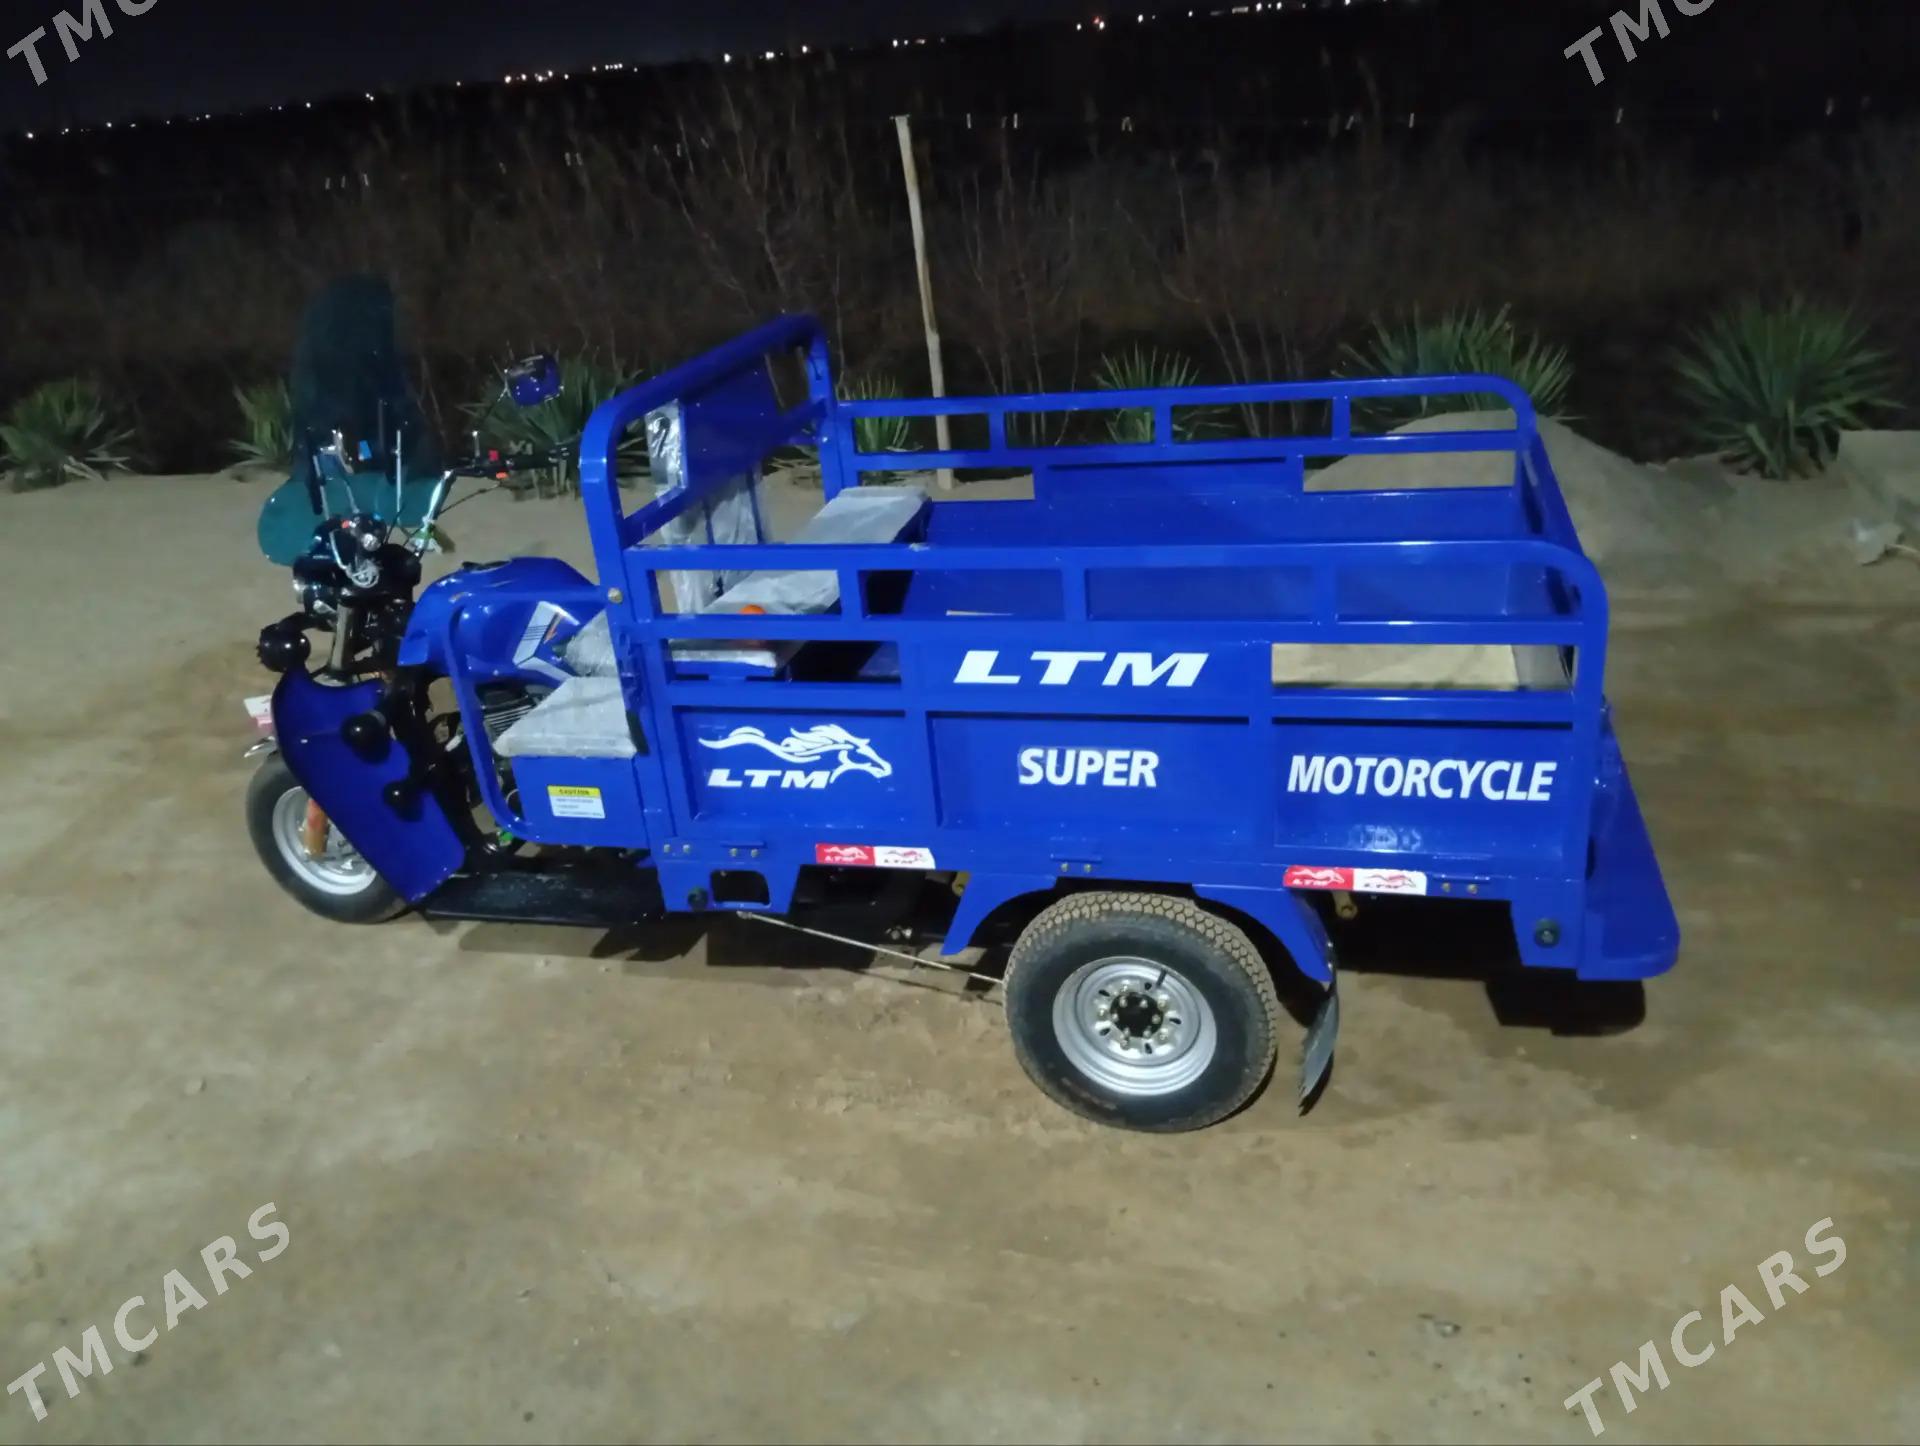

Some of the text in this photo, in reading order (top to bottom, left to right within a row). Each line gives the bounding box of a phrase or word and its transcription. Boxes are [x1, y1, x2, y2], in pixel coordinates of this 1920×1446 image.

[953, 650, 1209, 687] LTM
[707, 768, 830, 789] LTM
[1018, 748, 1557, 801] SUPER MOTORCYCLE
